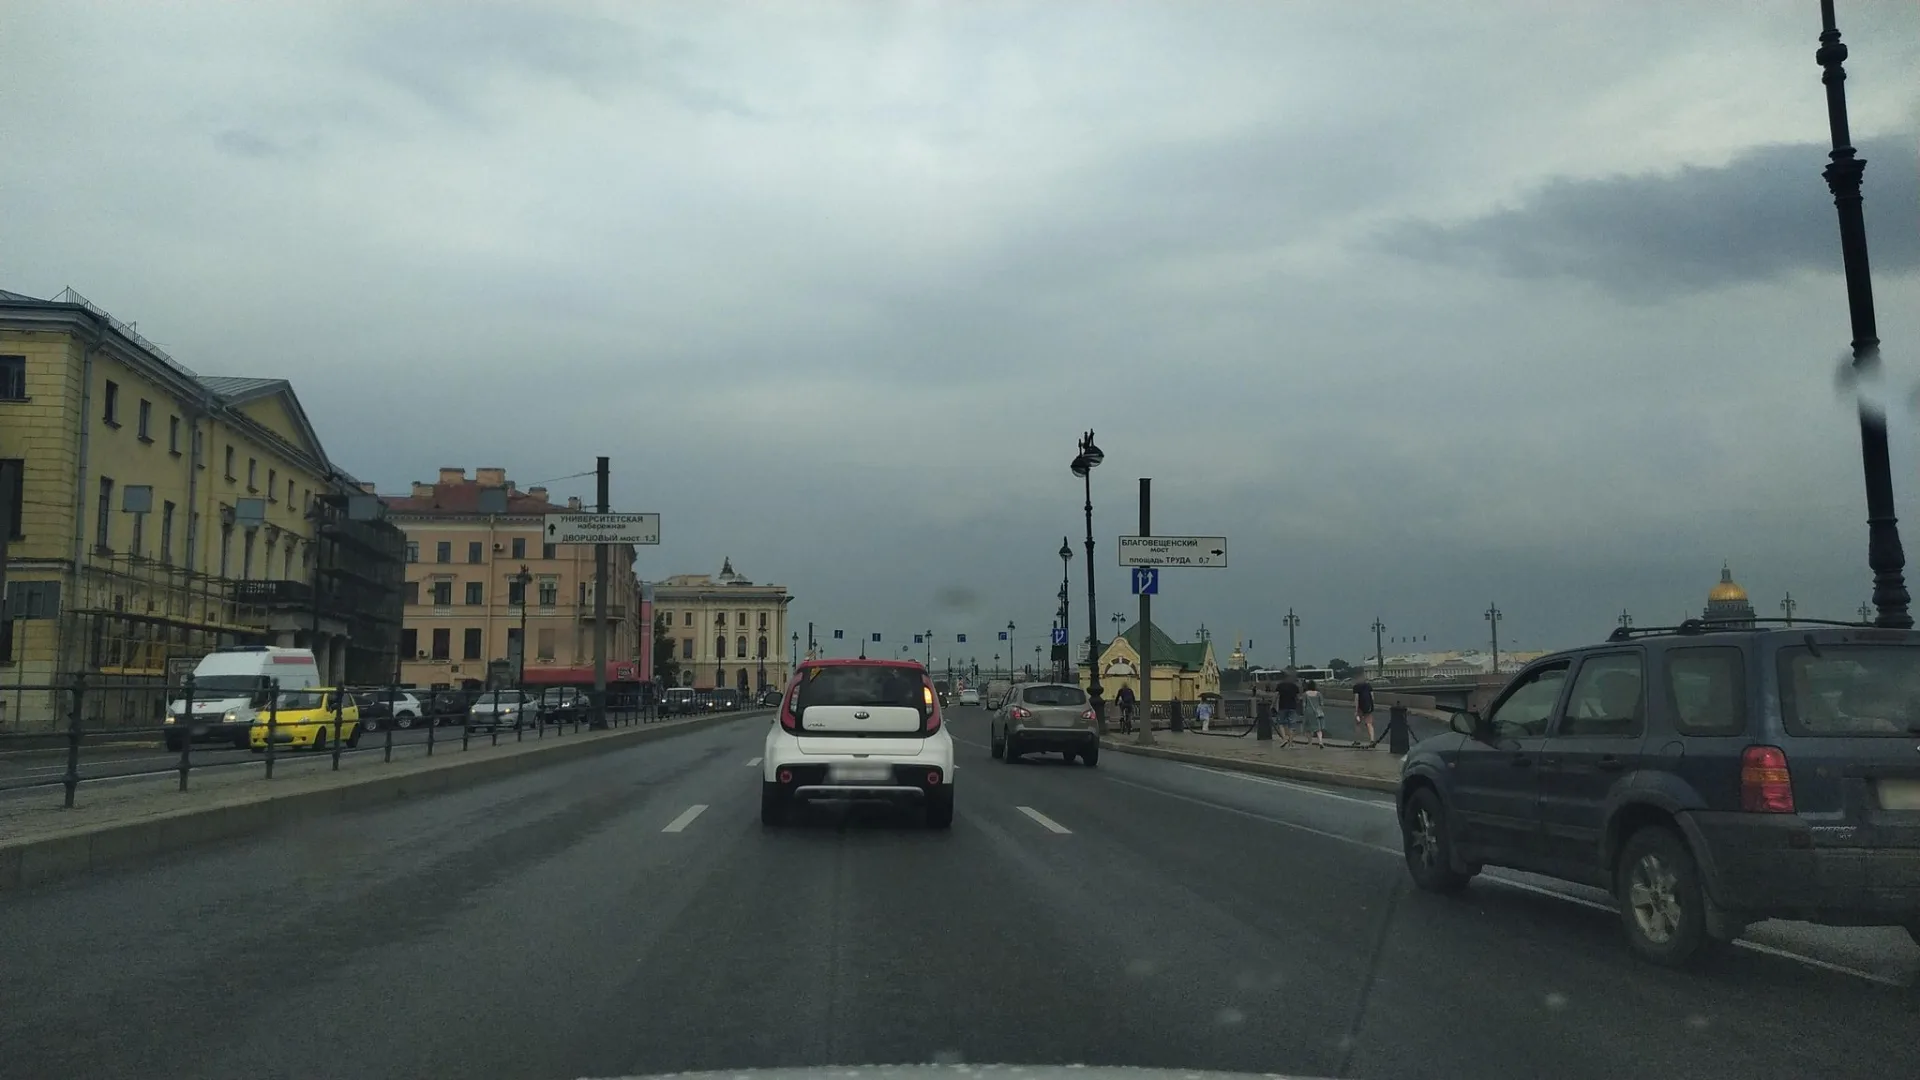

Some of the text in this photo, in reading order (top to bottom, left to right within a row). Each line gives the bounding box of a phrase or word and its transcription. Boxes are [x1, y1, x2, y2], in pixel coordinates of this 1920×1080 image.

[560, 515, 643, 523] УНИВЕРСИТЕТСКАЯ
[562, 533, 618, 542] ДВОРЦОВЫЙ
[1121, 539, 1198, 547] БЛАГОВЕЩЕНСКИЙ
[1166, 556, 1191, 564] ТРУДА
